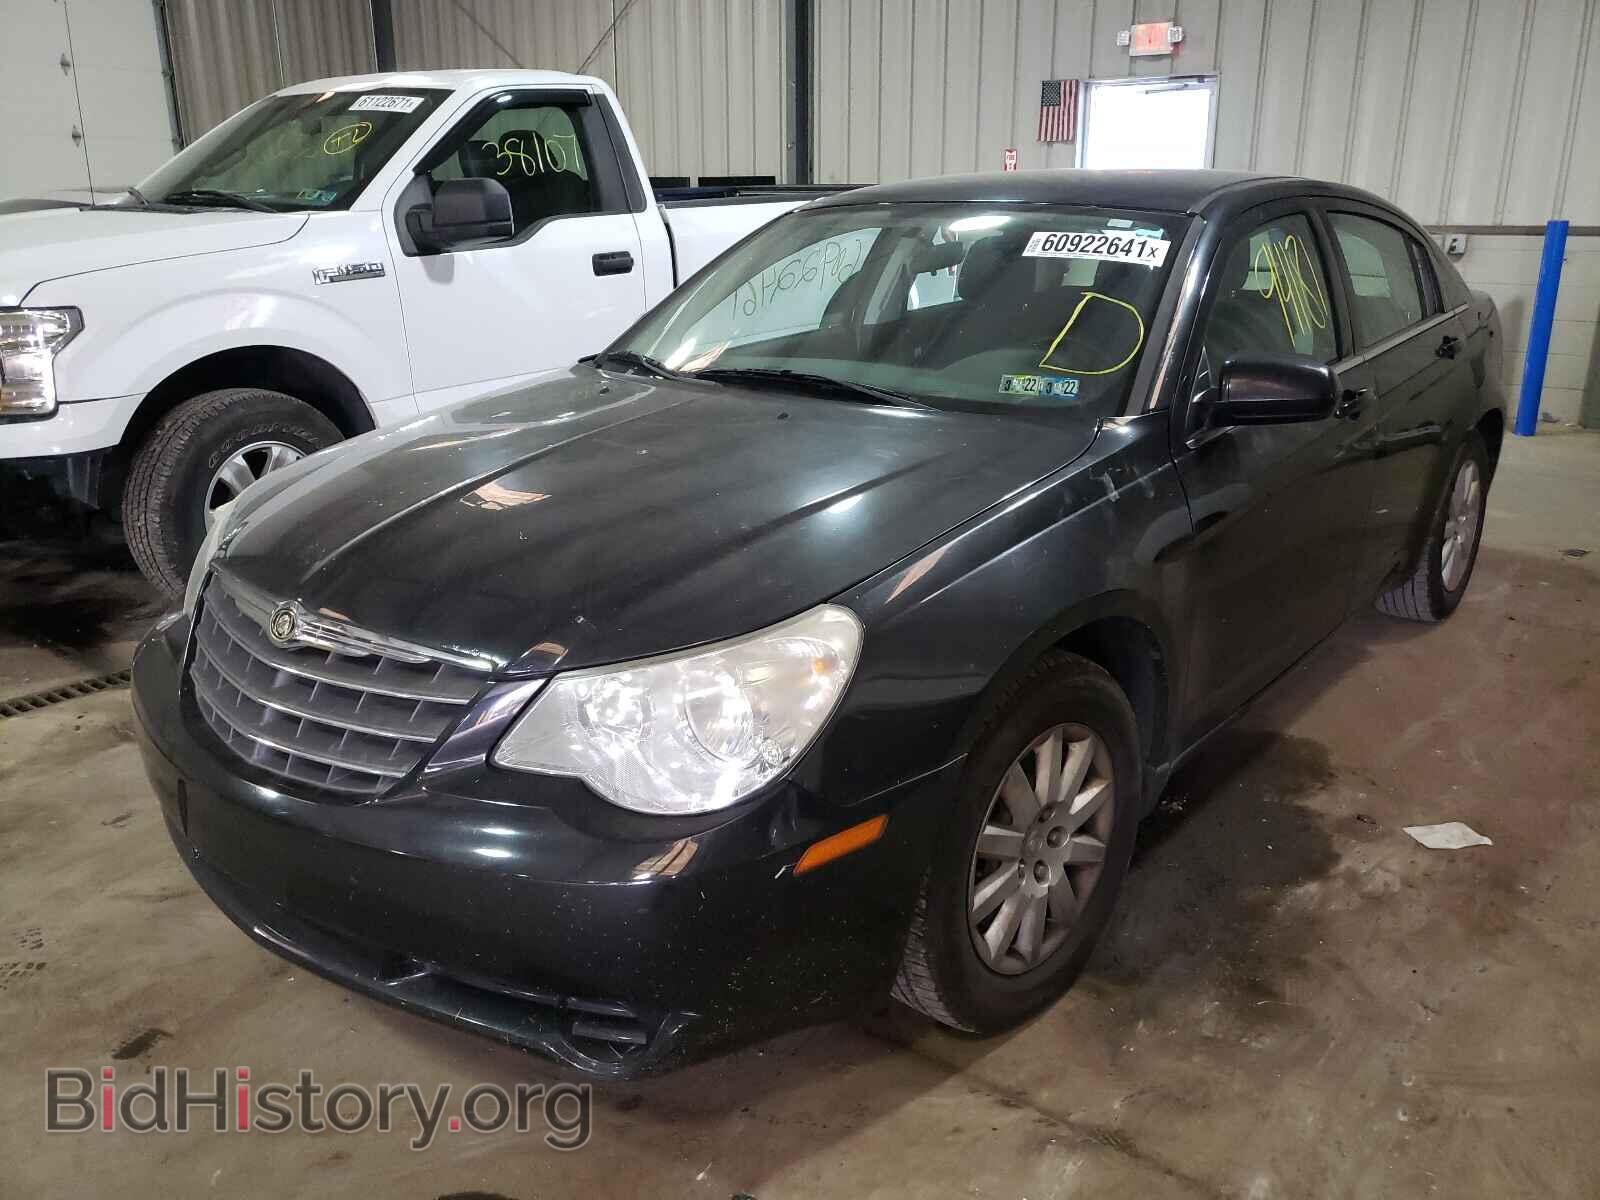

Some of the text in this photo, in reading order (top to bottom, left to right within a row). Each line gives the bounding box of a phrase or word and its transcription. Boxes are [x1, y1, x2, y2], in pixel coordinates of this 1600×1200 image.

[358, 96, 409, 109] 61122671
[482, 132, 580, 176] 38107
[1042, 234, 1148, 258] 60922641
[1039, 291, 1145, 375] D
[1024, 378, 1037, 392] 22
[1064, 380, 1076, 394] 22
